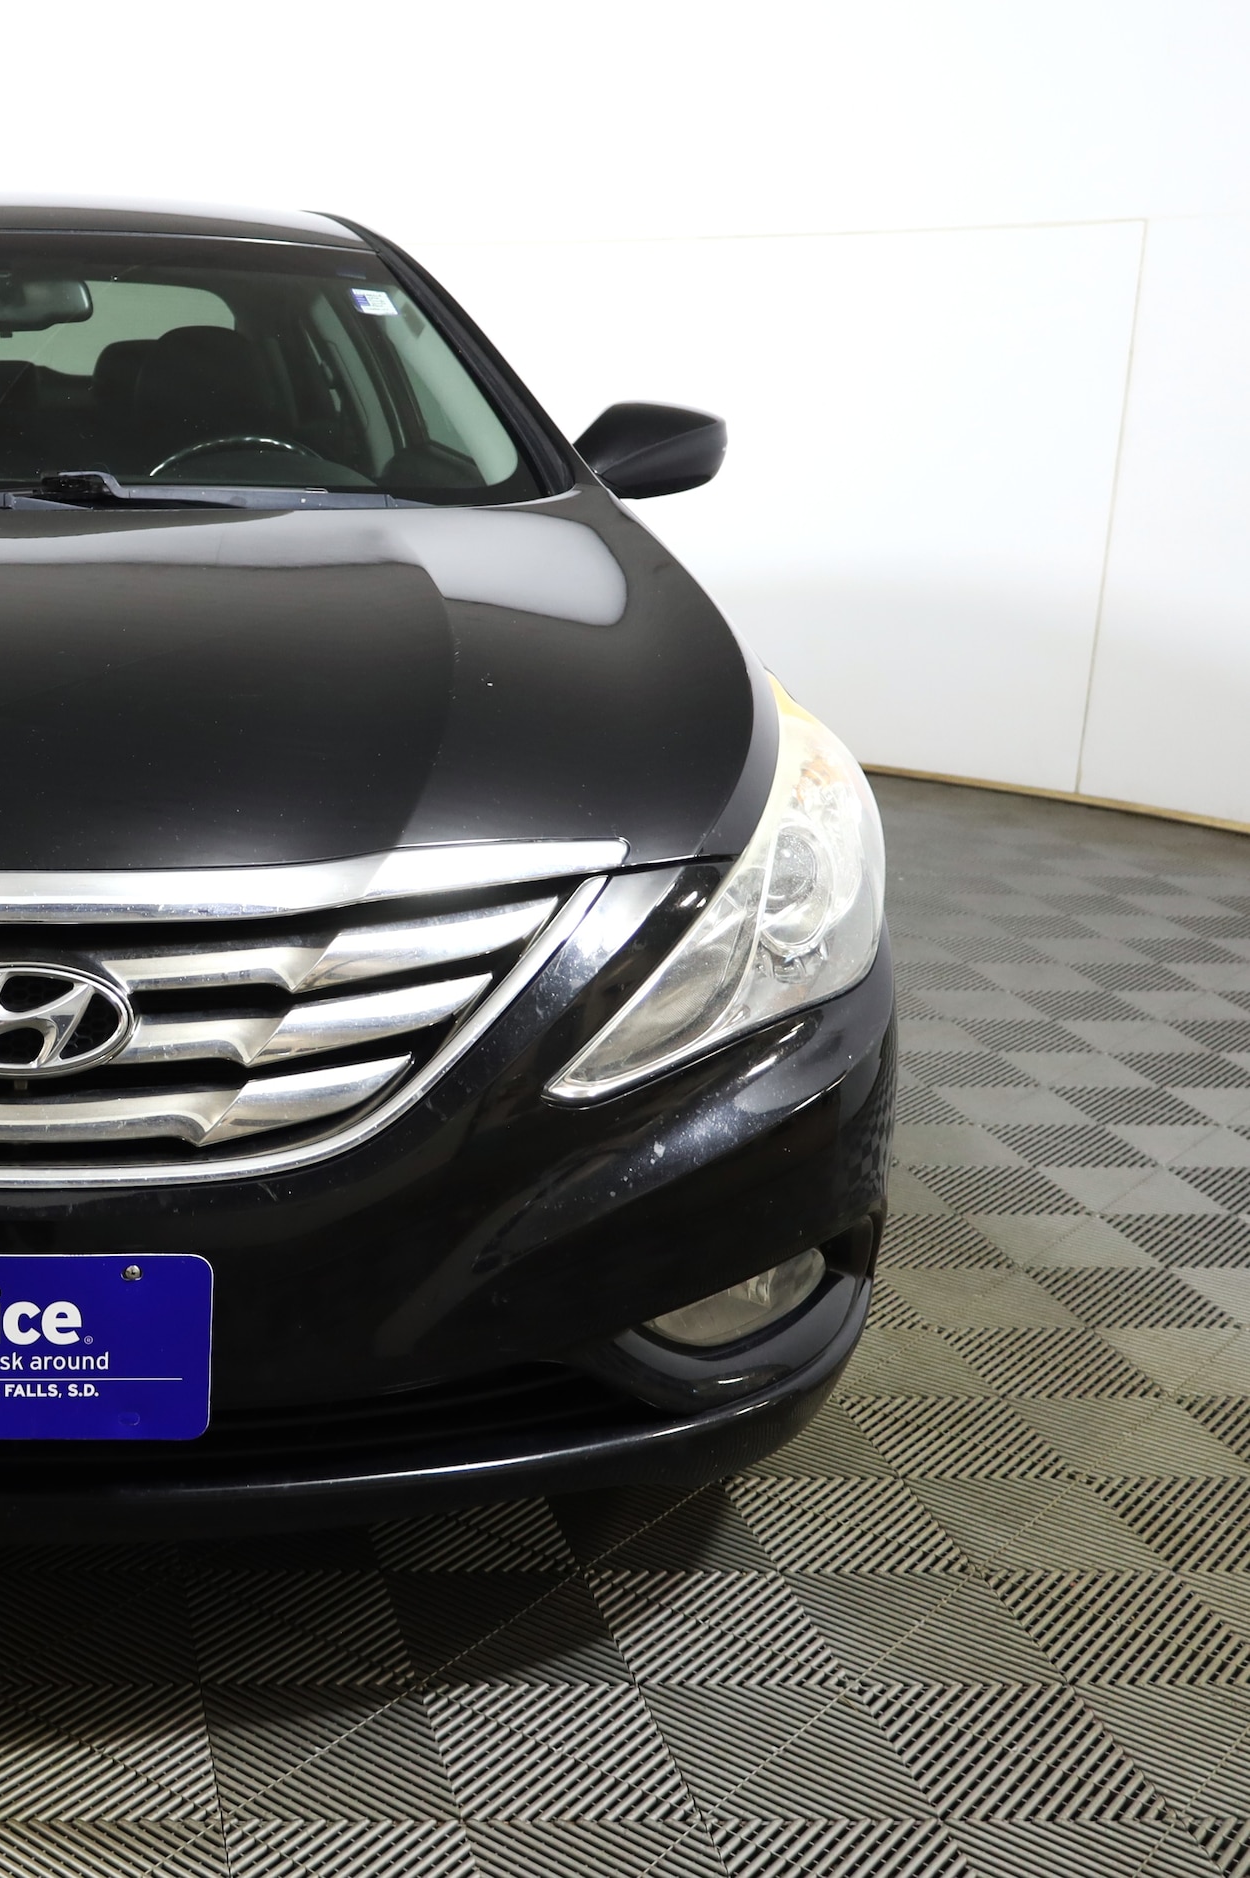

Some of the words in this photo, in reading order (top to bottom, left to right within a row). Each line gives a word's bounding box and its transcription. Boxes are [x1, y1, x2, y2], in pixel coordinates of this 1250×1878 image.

[30, 1352, 108, 1370] around
[5, 1384, 62, 1398] FALLS,
[68, 1384, 99, 1397] S.D.
